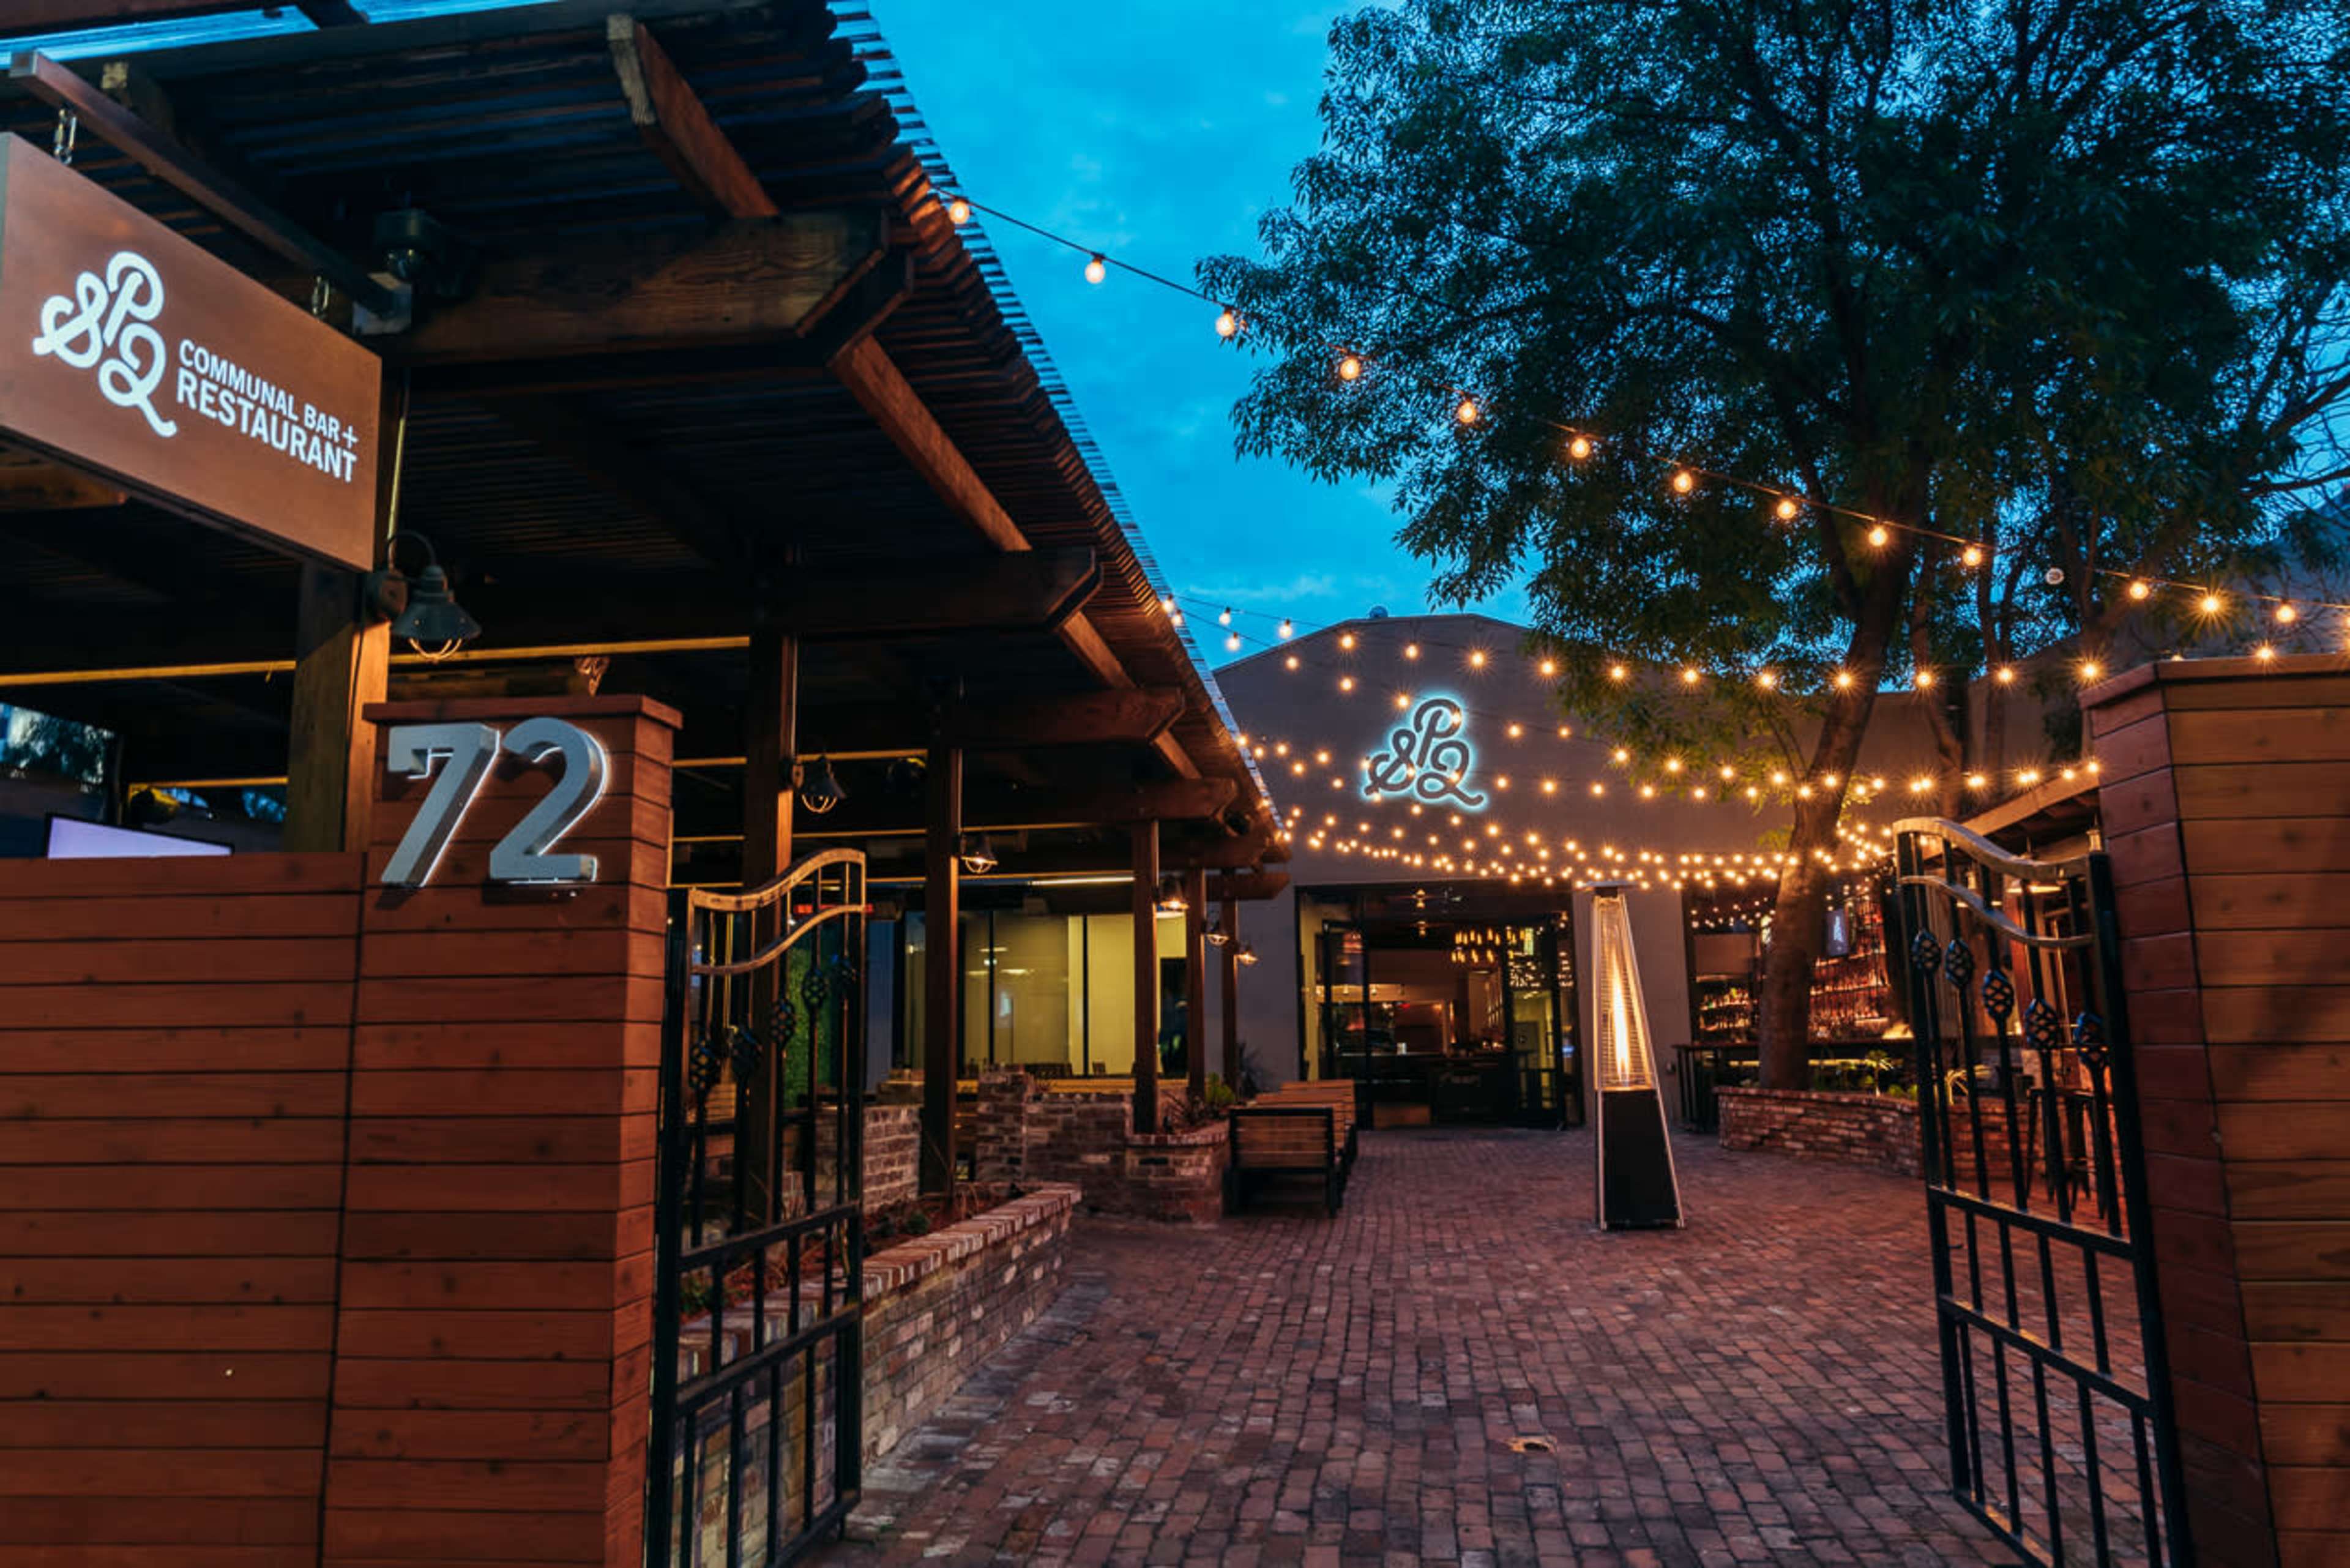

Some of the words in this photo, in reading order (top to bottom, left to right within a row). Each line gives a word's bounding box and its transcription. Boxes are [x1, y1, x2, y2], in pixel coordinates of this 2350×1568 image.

[177, 367, 357, 483] RESTAURANT
[179, 338, 299, 422] COMMUNAL
[381, 717, 607, 887] 72
